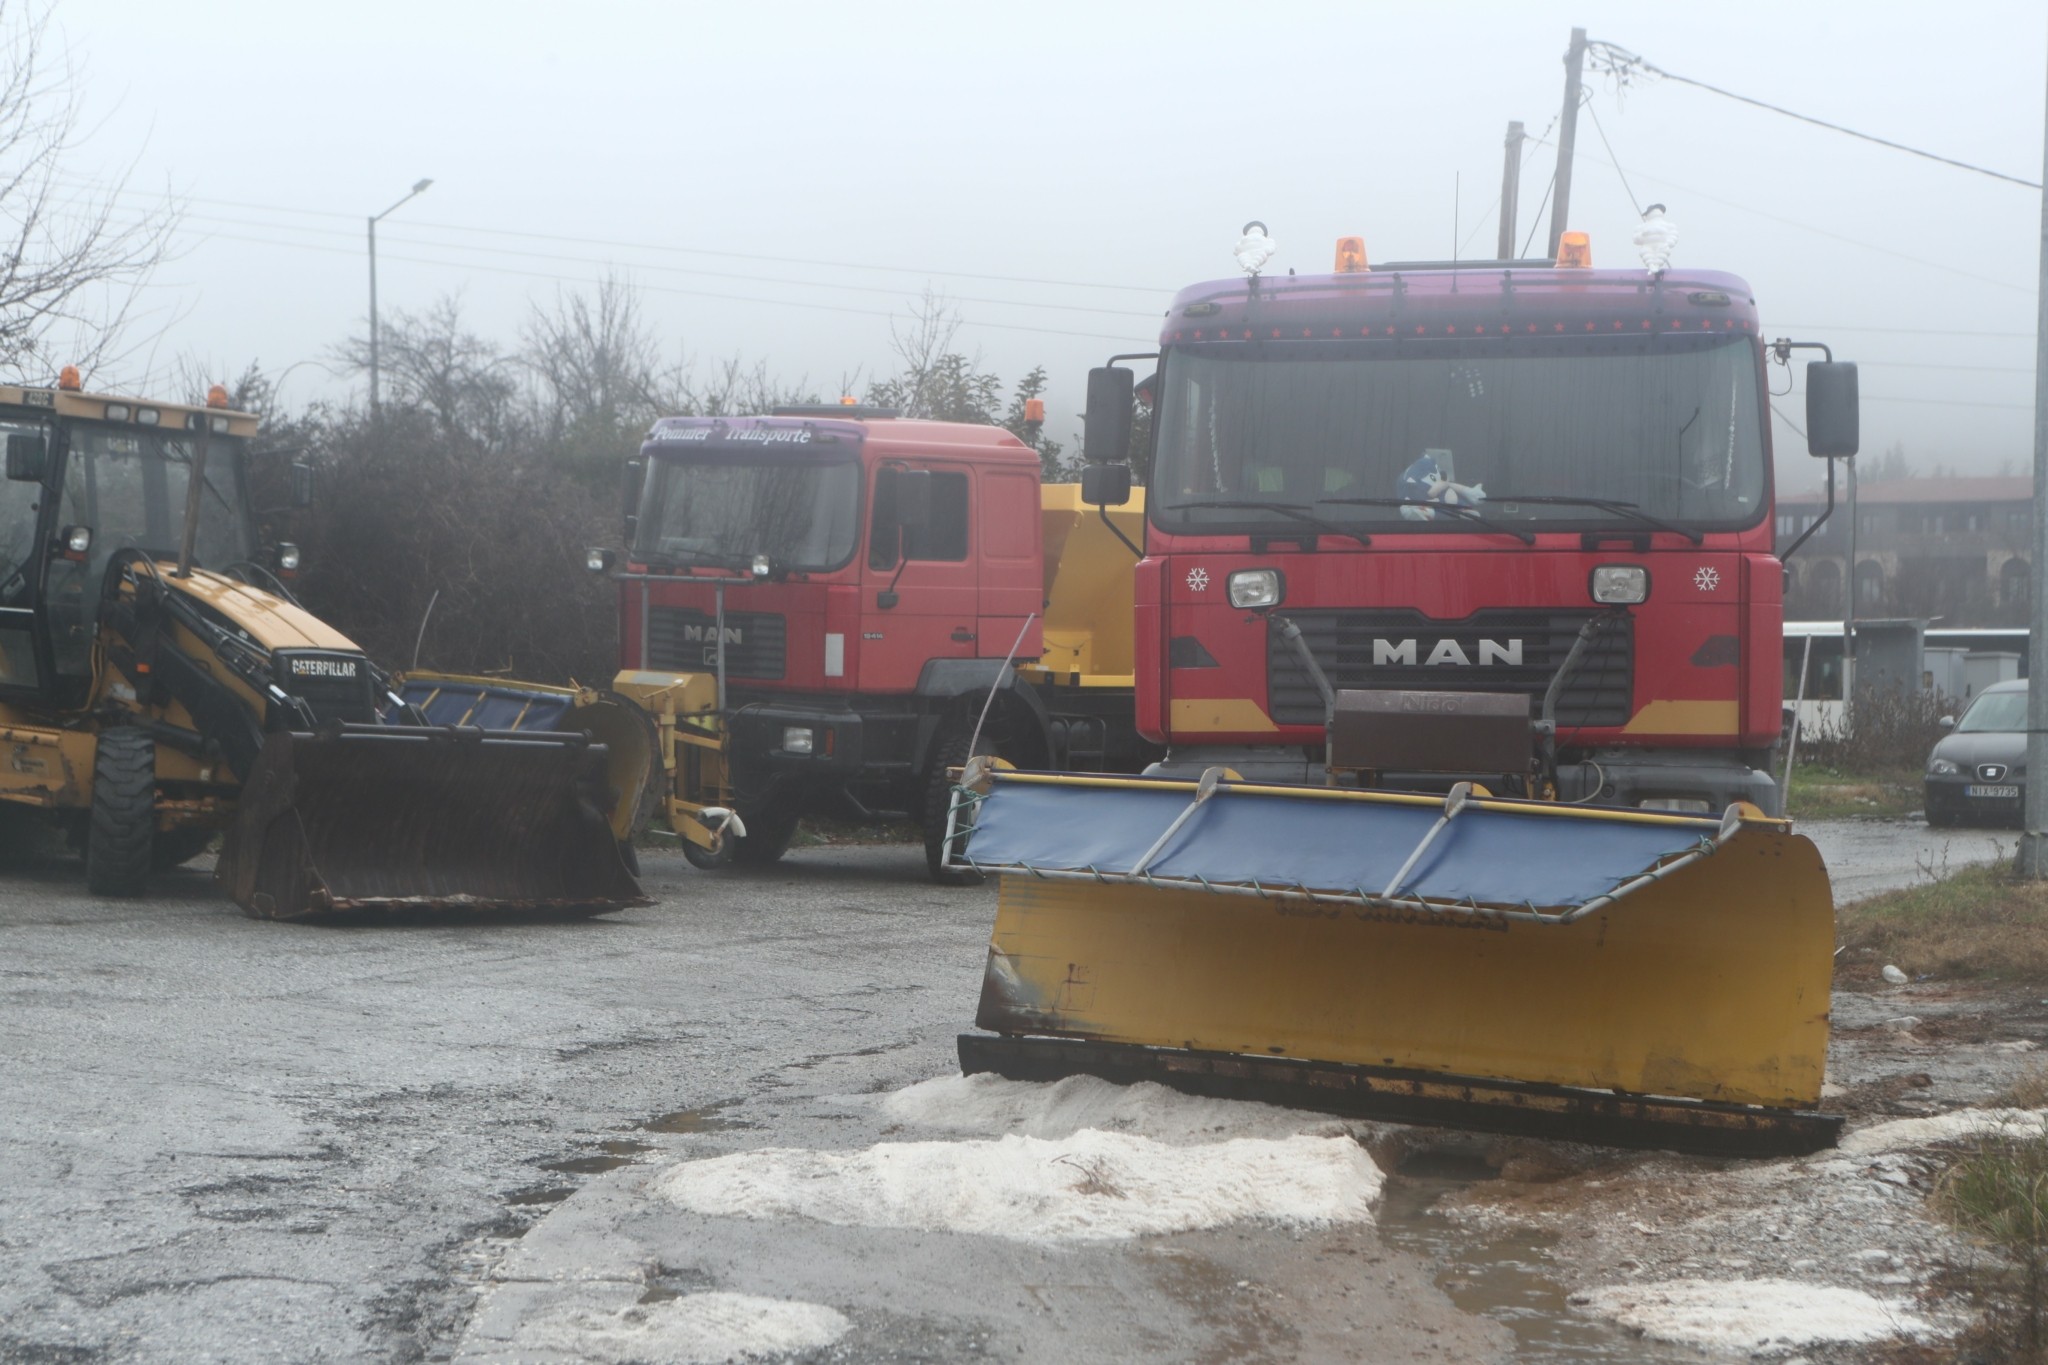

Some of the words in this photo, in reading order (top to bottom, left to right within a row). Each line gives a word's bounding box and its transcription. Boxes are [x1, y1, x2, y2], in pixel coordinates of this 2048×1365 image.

[725, 427, 811, 445] Transporte
[684, 624, 742, 645] MAN
[1373, 638, 1523, 666] MAN
[292, 659, 356, 677] CATERPILLAR
